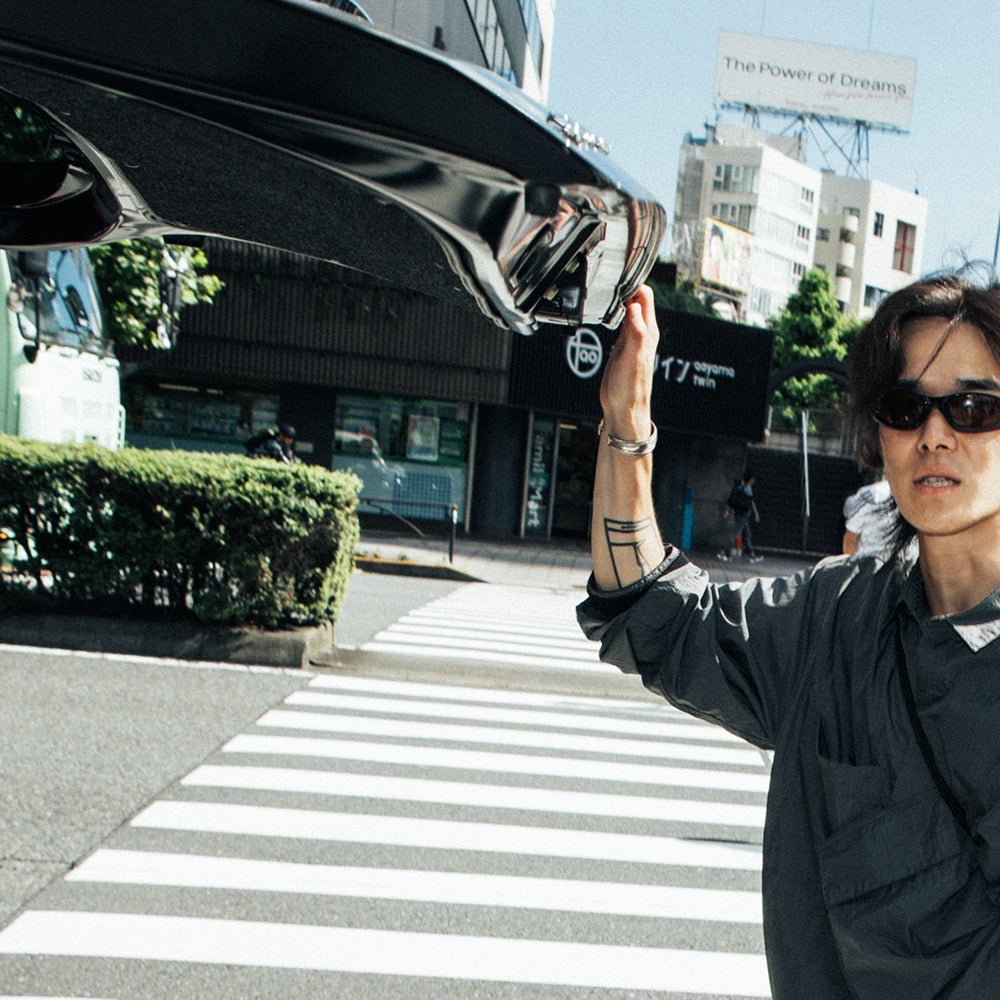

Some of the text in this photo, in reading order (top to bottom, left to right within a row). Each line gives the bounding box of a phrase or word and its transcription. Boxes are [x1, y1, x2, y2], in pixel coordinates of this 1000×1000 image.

[724, 56, 907, 96] The Power of Dreams
[653, 354, 690, 383] イン
[693, 361, 736, 379] aoyama
[693, 374, 716, 389] twin
